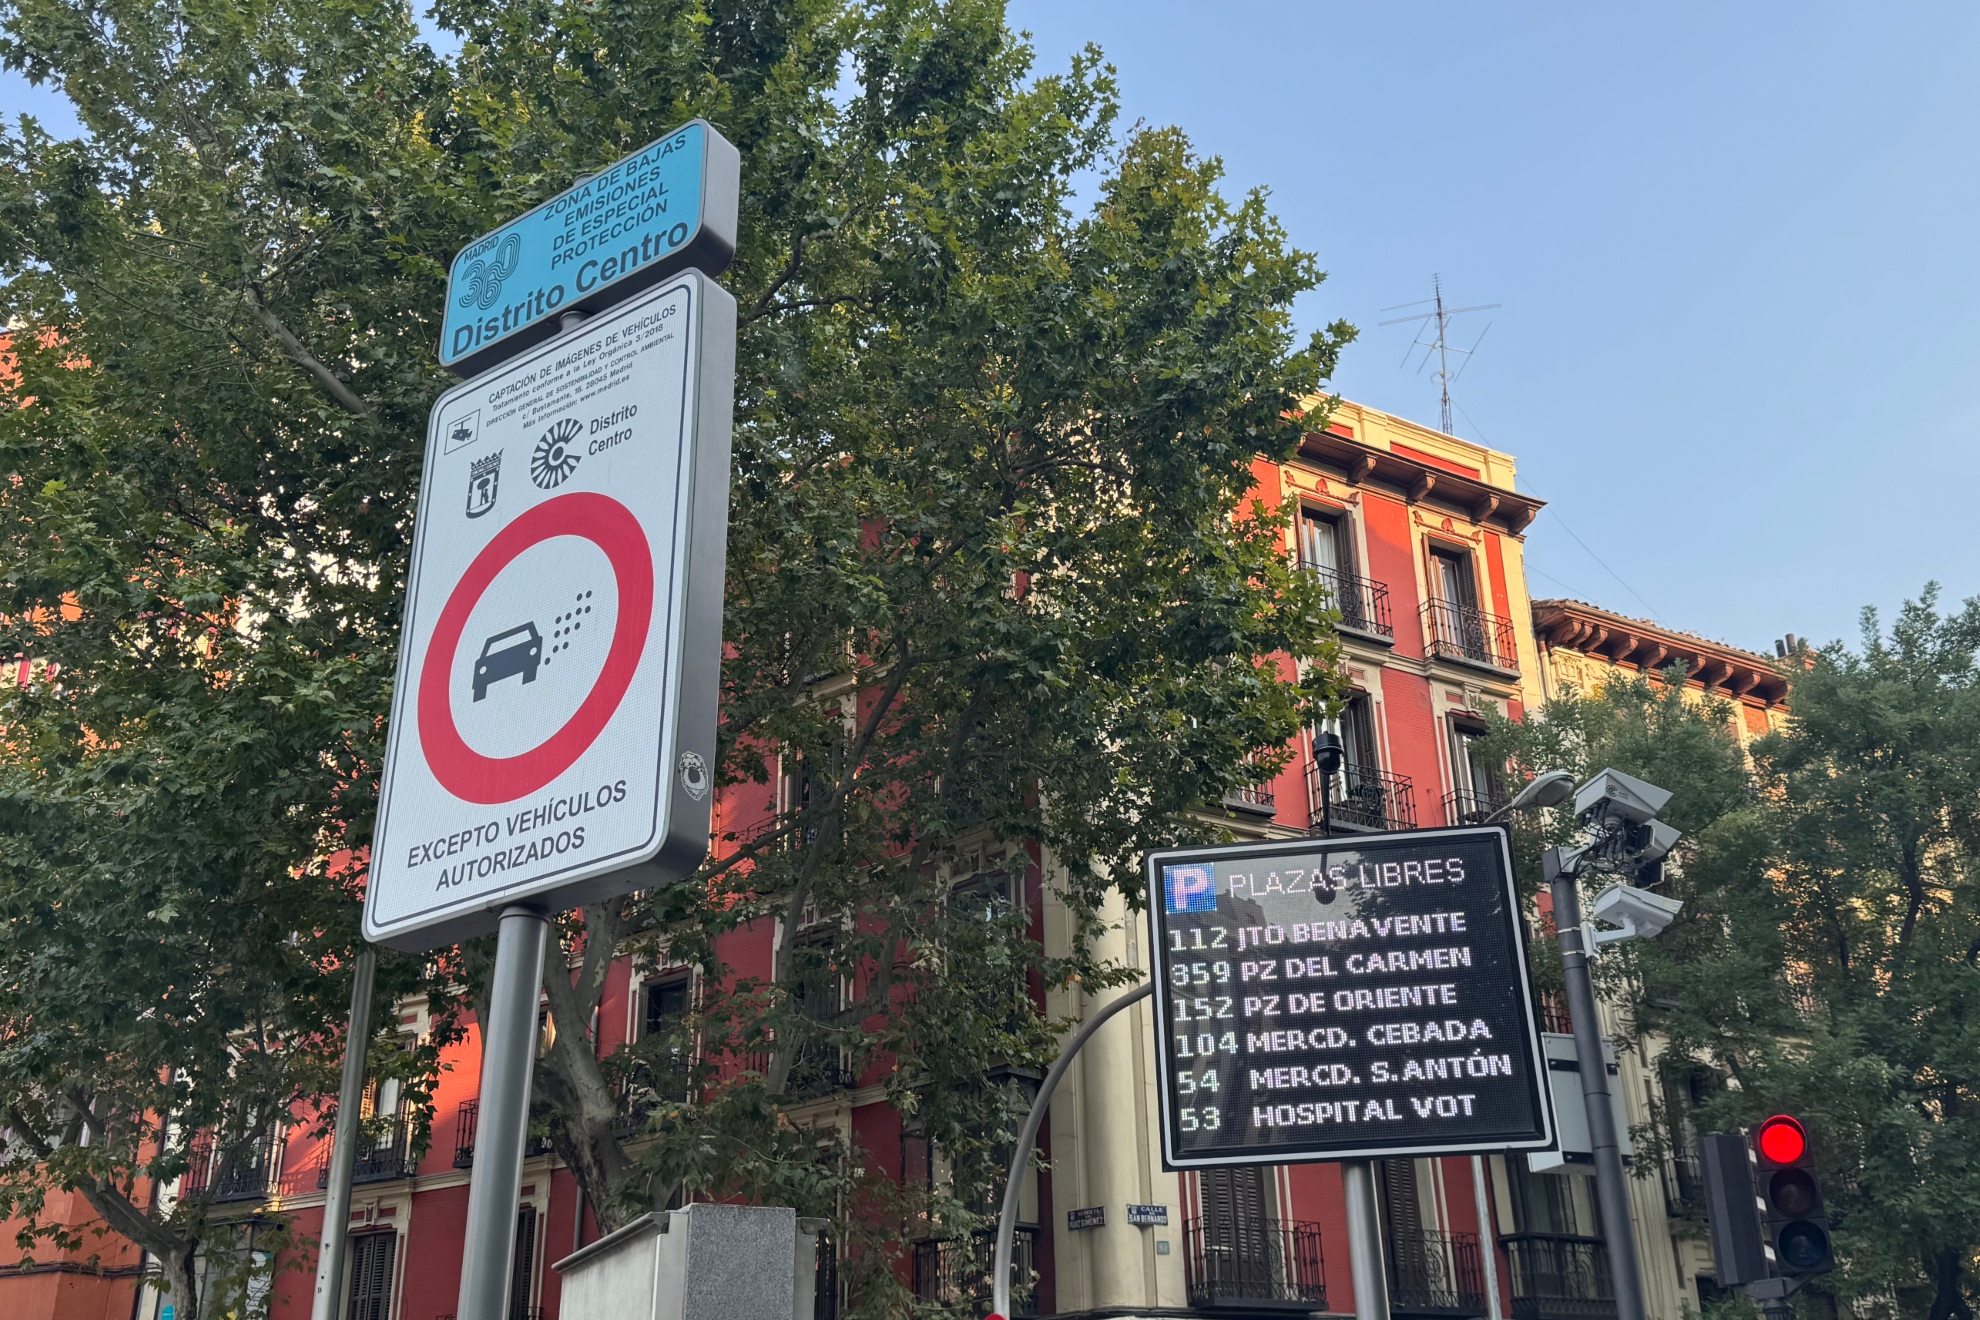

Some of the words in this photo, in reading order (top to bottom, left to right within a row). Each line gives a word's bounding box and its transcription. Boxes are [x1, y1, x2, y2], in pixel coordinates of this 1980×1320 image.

[544, 187, 591, 221] ZONA
[598, 173, 620, 192] DE
[626, 134, 686, 177] BAJAS
[564, 166, 660, 227] EMISIONES
[551, 198, 668, 270] PROTECCIÓN
[553, 230, 576, 251] DE
[581, 182, 669, 237] ESPECIAL
[459, 233, 520, 310] 360
[463, 236, 499, 264] MADRID
[452, 285, 564, 358] Distrito
[576, 222, 688, 293] Centro
[486, 406, 516, 428] DIRECCIÓN
[518, 396, 544, 412] GENERAL
[546, 390, 553, 398] DE
[556, 367, 602, 393] SOSTENIBILIDAD
[611, 350, 638, 367] CONTROL
[640, 332, 674, 352] AMBIENTAL
[488, 373, 536, 404] CAPTACIÓN
[540, 365, 552, 380] DE
[555, 340, 602, 372] IMÁGENES
[606, 332, 618, 347] DE
[622, 304, 676, 338] VEHÍCULOS
[492, 390, 530, 412] Tratamiento
[532, 372, 564, 393] conforme
[574, 364, 580, 373] la
[584, 358, 596, 368] Ley
[599, 340, 632, 360] Orgánica
[635, 324, 664, 342] 3/2018
[522, 409, 530, 420] c/
[532, 393, 572, 415] Bustamante,
[586, 374, 608, 390] 28045
[610, 361, 633, 377] Madrid
[523, 420, 535, 429] Más
[538, 399, 577, 422] Información:
[580, 375, 630, 402] www.madrid.es
[588, 427, 633, 456] Centro
[590, 404, 638, 436] Distrito
[407, 821, 500, 869] EXCEPTO
[506, 779, 628, 837] VEHÍCULOS
[436, 826, 586, 892] AUTORIZADOS
[1230, 866, 1347, 898] PLAZAS
[1359, 858, 1465, 890] LIBRES
[1170, 927, 1228, 952] 112
[1238, 925, 1284, 952] JTO
[1292, 912, 1468, 944] BENAVENTE
[1172, 961, 1230, 986] 359
[1240, 960, 1278, 982] PZ
[1285, 956, 1338, 978] DEL
[1346, 946, 1472, 975] CARMEN
[1174, 997, 1234, 1022] 152
[1243, 996, 1280, 1017] PZ
[1288, 992, 1326, 1014] DE
[1334, 984, 1458, 1012] ORIENTE
[1175, 1032, 1238, 1058] 104
[1246, 1027, 1357, 1054] MERCD.
[1367, 1018, 1493, 1046] CEBADA
[1178, 1069, 1220, 1094] 54
[1250, 1063, 1361, 1090] MERCD.
[1180, 1106, 1220, 1132] 53
[1252, 1098, 1403, 1128] HOSPITAL
[1412, 1094, 1476, 1119] VOT
[1128, 1214, 1140, 1222] SAN
[1141, 1215, 1167, 1223] BERNARDO
